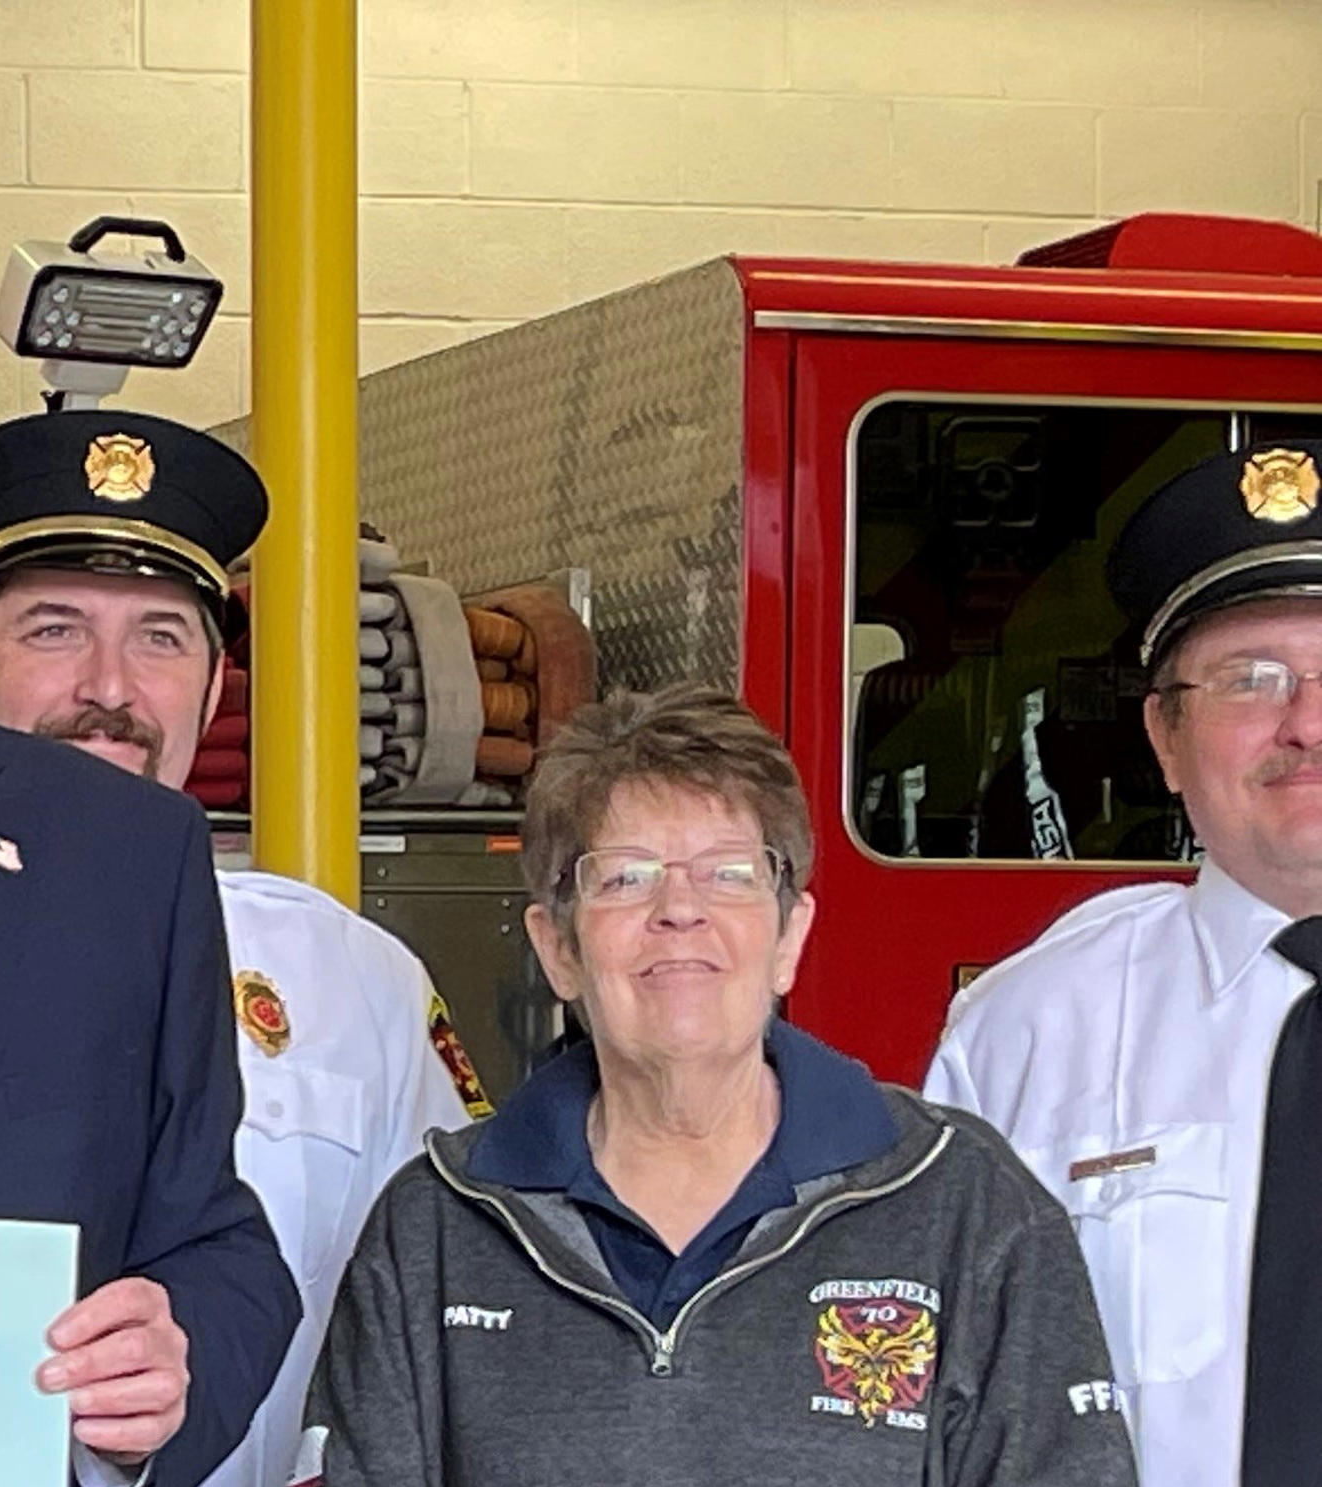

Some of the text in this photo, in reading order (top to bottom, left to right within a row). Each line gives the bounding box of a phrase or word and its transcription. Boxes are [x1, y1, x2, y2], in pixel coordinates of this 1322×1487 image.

[809, 1279, 941, 1314] GREENFIELD
[443, 1304, 514, 1330] PATTY
[859, 1305, 897, 1323] 70
[810, 1396, 928, 1430] FIRE EMS
